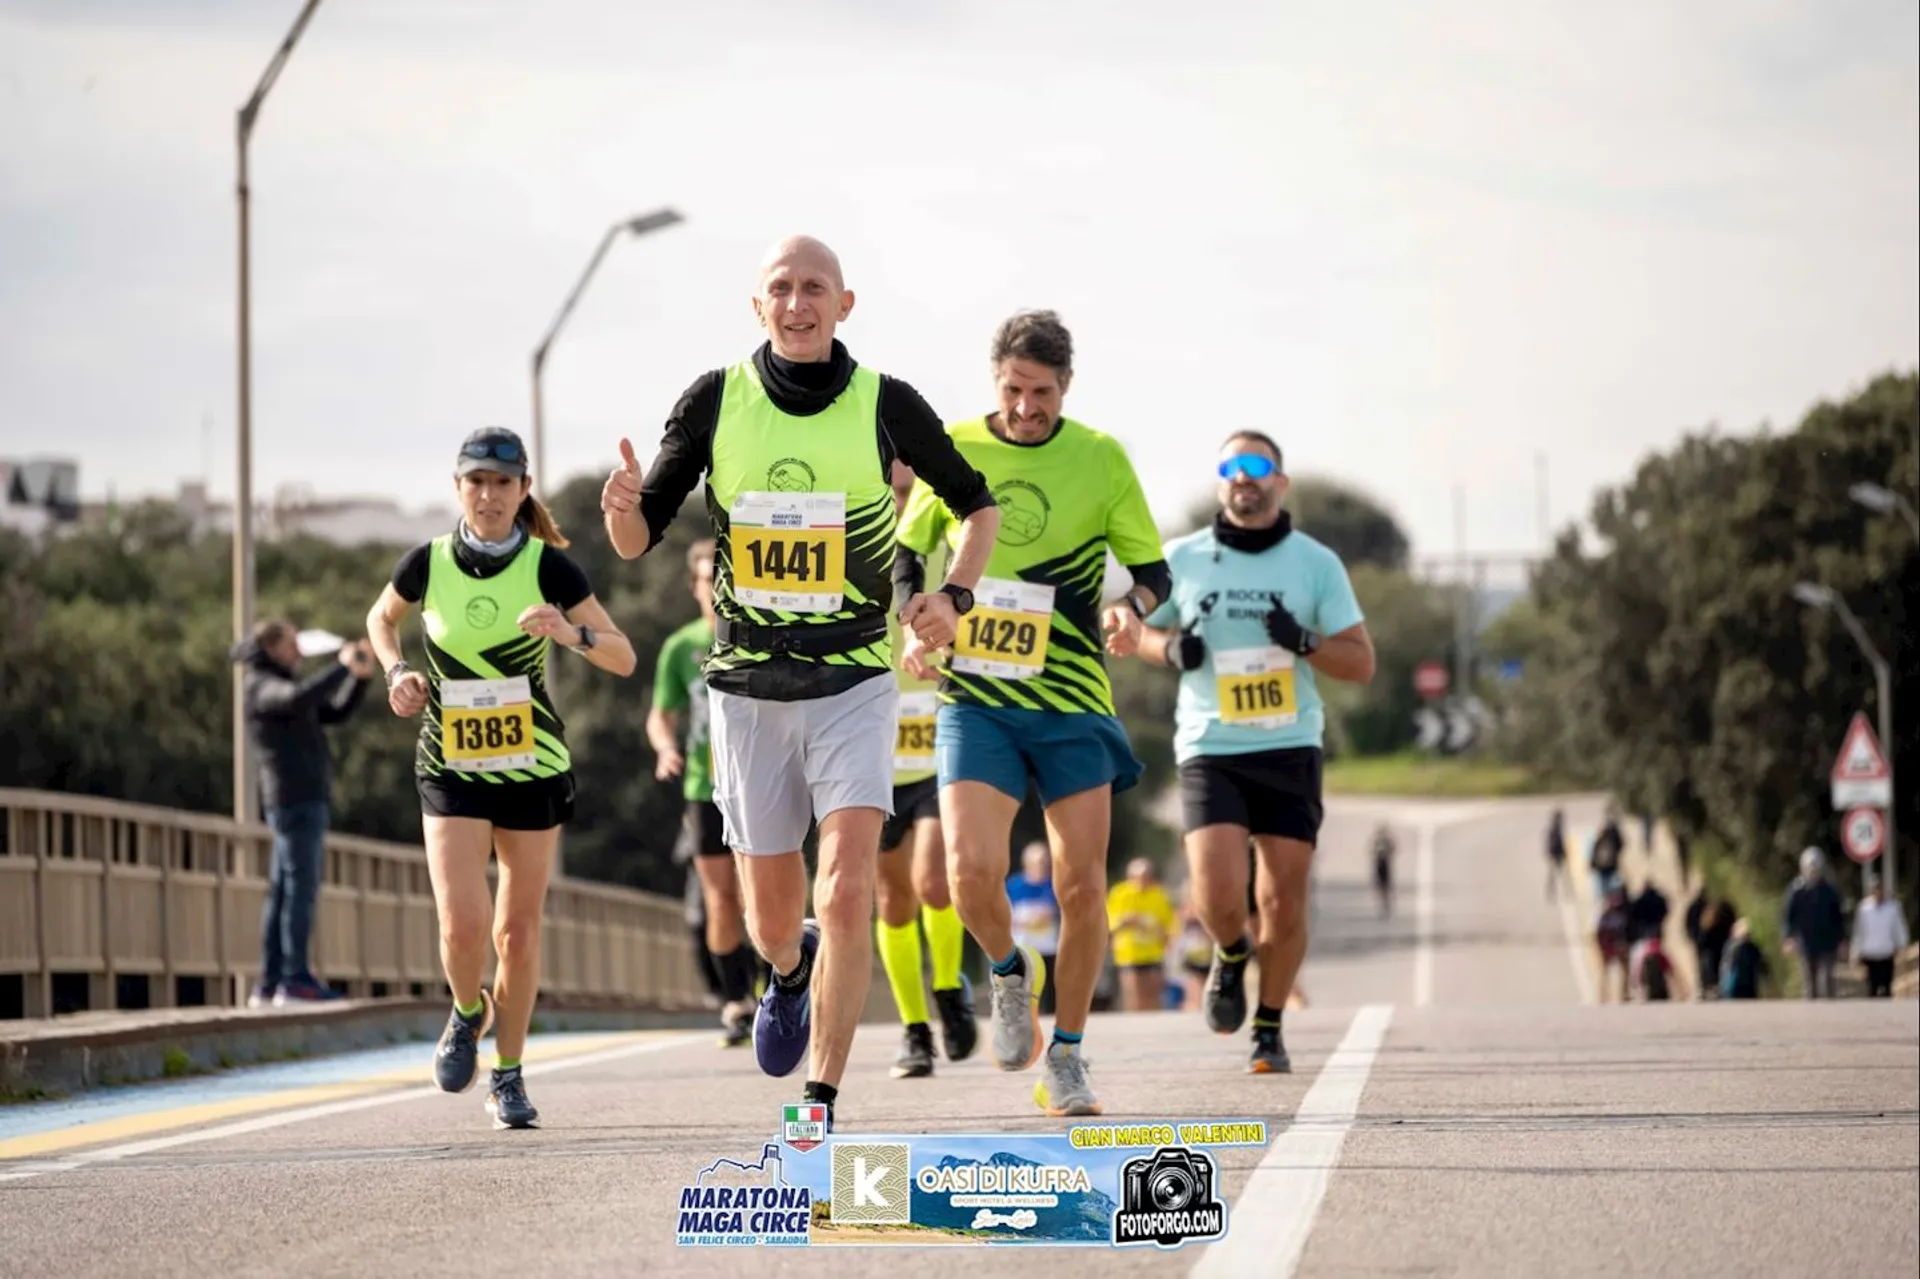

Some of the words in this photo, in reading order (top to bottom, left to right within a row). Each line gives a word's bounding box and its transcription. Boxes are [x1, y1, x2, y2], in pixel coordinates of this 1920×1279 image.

[746, 540, 826, 581] 1441
[967, 615, 1036, 657] 1429
[1231, 679, 1284, 711] 1116
[451, 715, 524, 750] 1383
